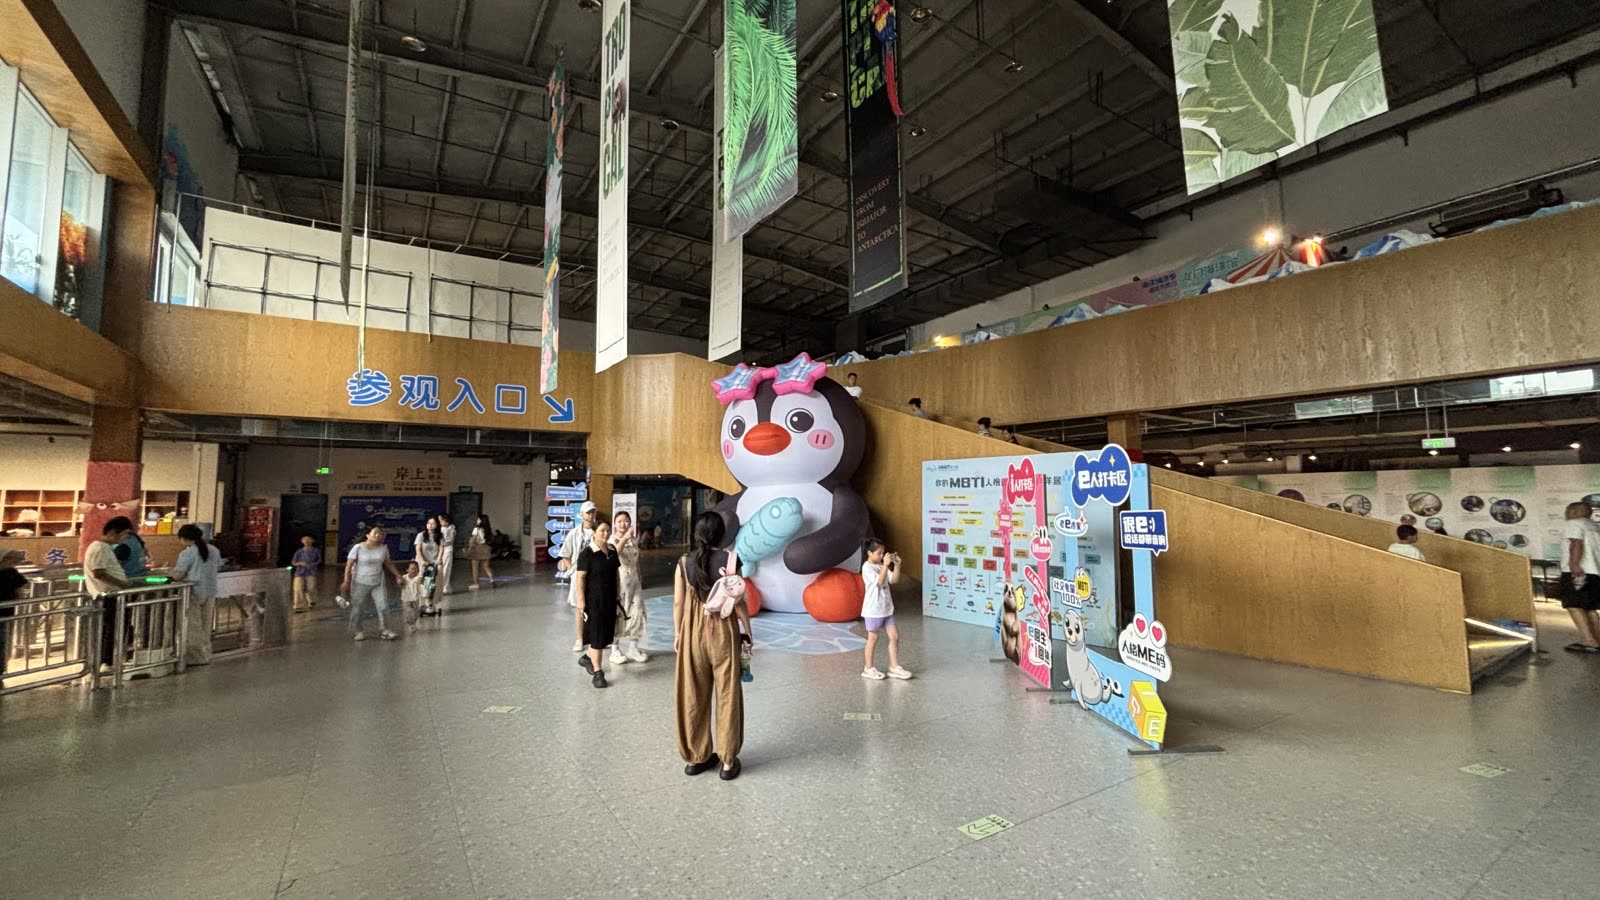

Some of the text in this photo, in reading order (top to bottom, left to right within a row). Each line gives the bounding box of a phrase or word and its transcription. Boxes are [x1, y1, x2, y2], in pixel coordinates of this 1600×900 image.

[855, 200, 875, 218] FROM
[856, 205, 888, 230] EQUATOR
[857, 230, 867, 241] TO
[857, 223, 899, 254] ANTARCTICA
[346, 368, 527, 414] 参观入口
[1124, 533, 1166, 546] 说话都带音响
[1061, 592, 1082, 606] 100%
